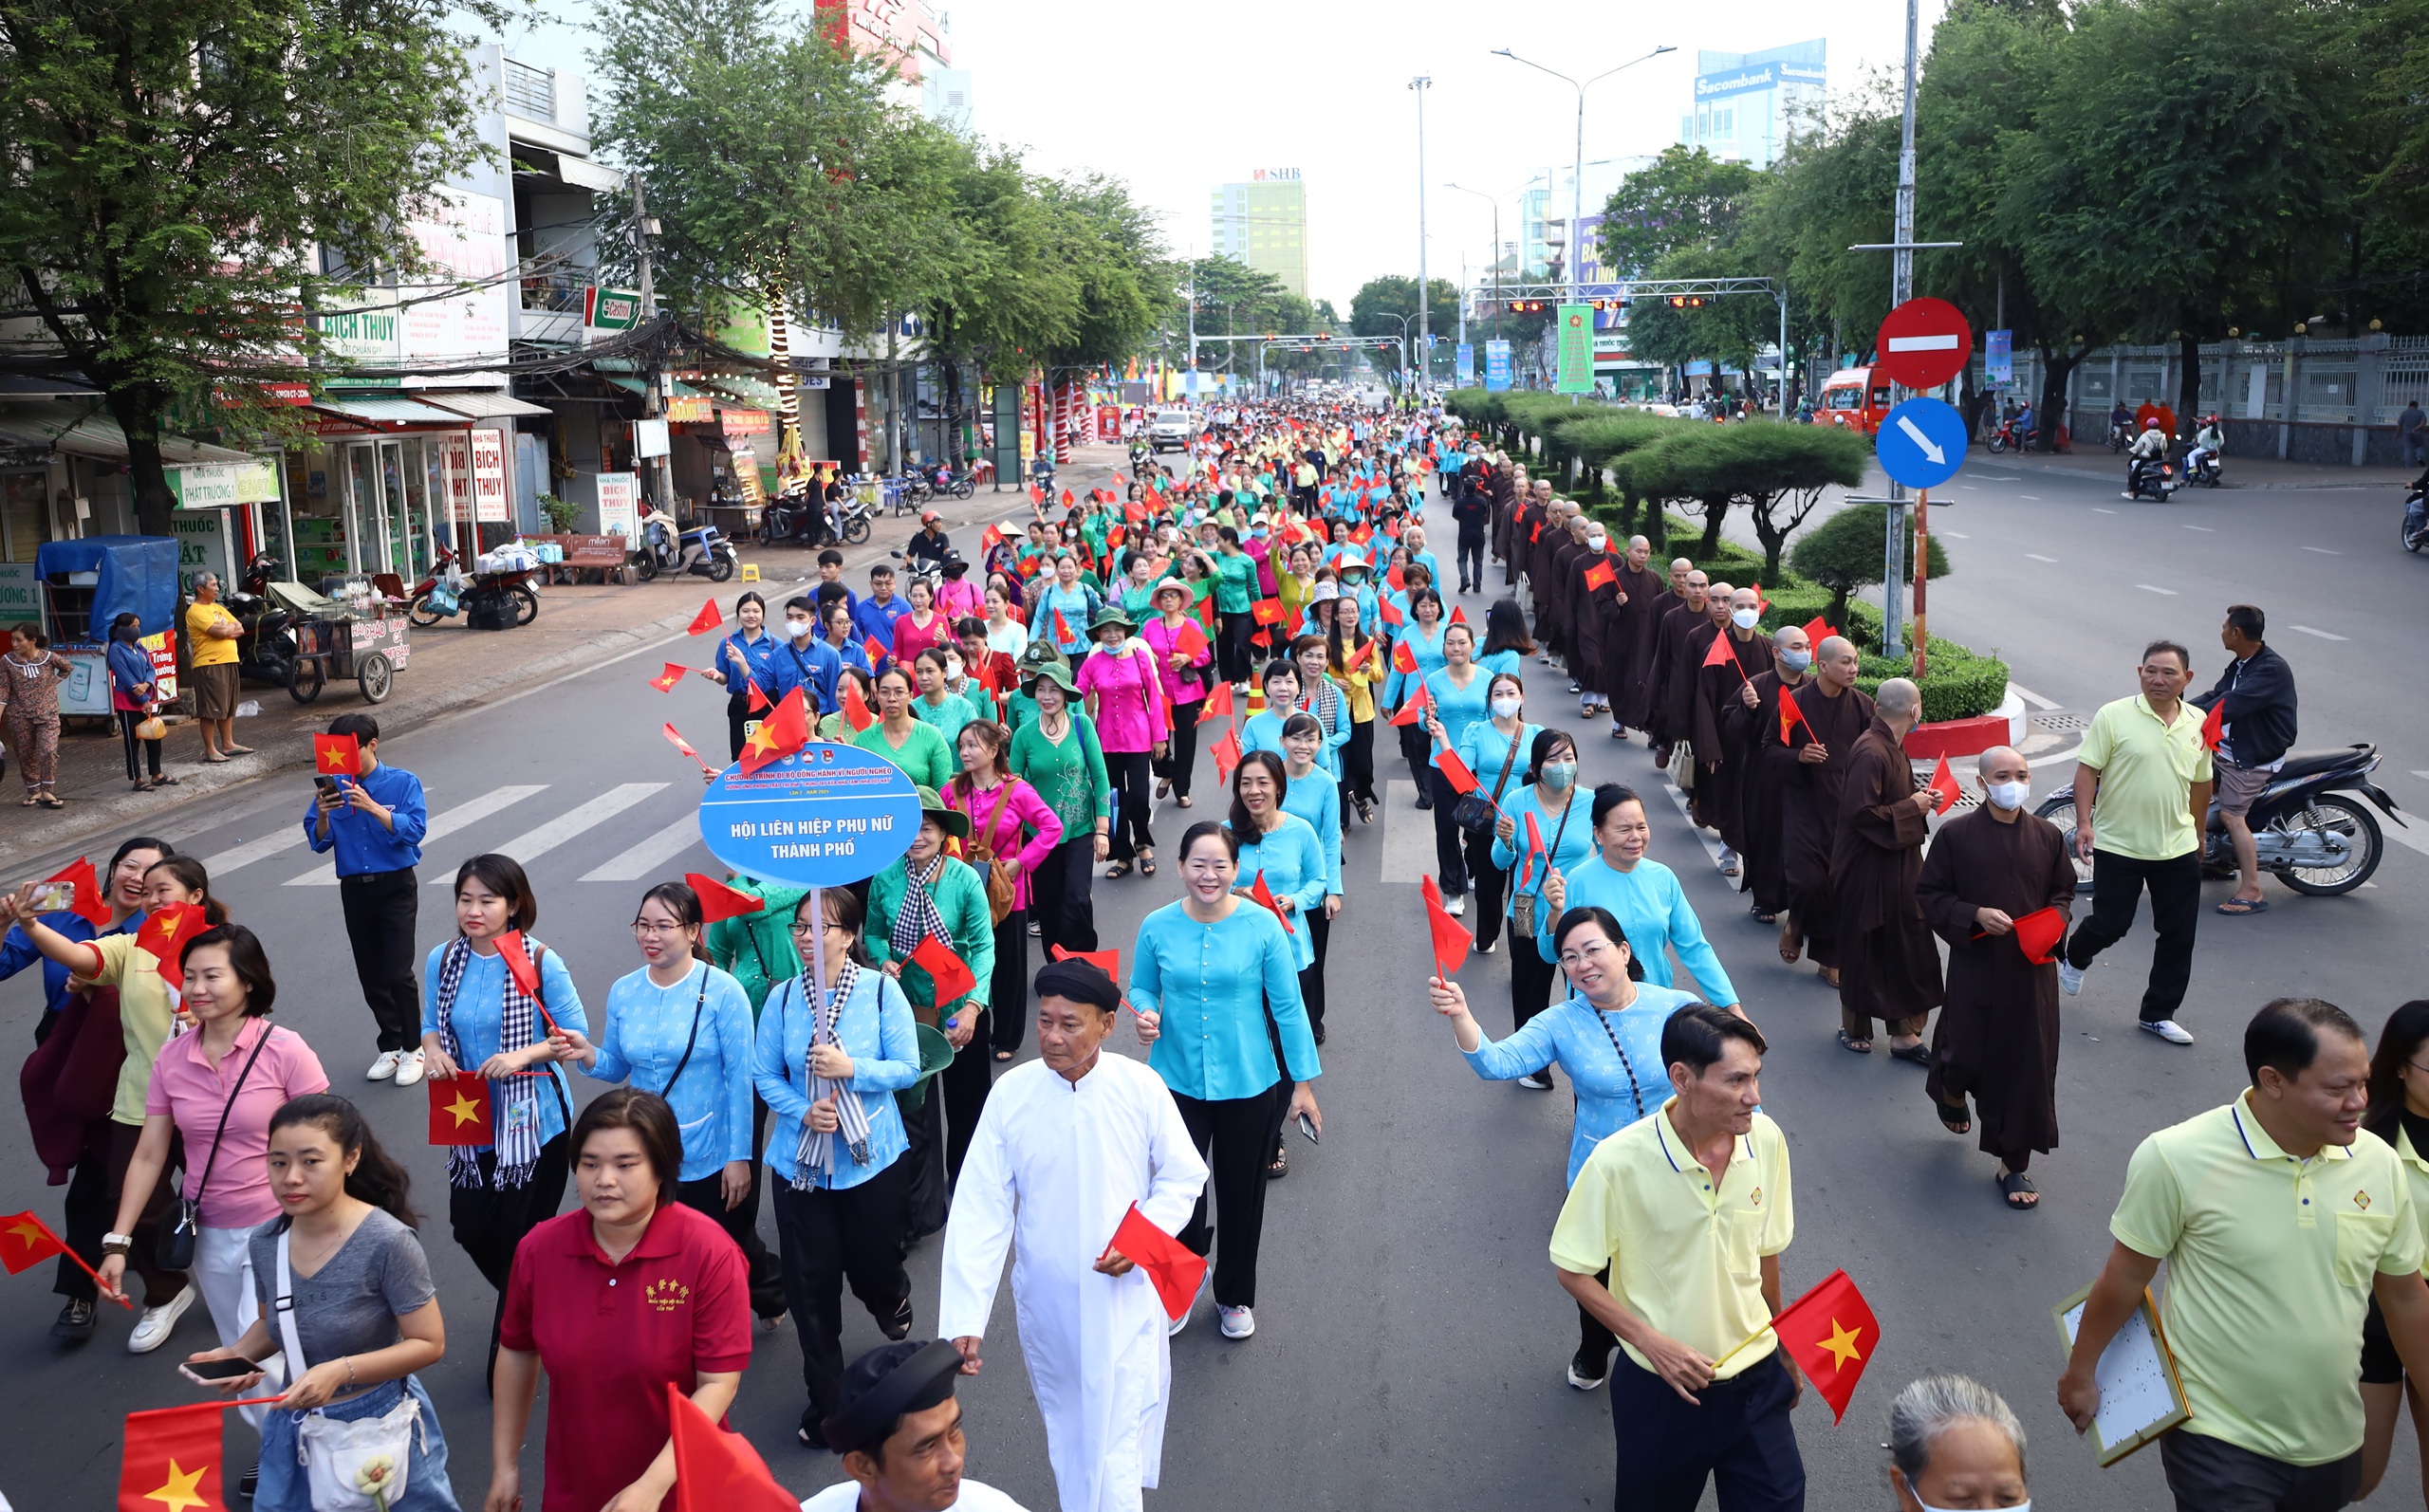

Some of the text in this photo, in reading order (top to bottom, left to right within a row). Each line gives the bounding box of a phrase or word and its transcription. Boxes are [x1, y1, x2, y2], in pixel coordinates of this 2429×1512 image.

[1780, 63, 1826, 79] Sacombank
[1697, 68, 1773, 95] Sacombank
[1270, 167, 1300, 180] SHB
[609, 302, 630, 320] Castrol
[473, 432, 498, 443] NHÀ THUỐC
[475, 446, 499, 469] BÍCH
[477, 471, 501, 496] THỦY
[603, 485, 626, 495] BÍCH
[185, 485, 202, 502] PHÁT
[602, 496, 629, 507] THỦY
[173, 516, 215, 533] THUỐC
[0, 568, 20, 578] HUỐC
[31, 588, 37, 604] 1
[755, 770, 775, 780] TRÌNH
[776, 771, 784, 779] ĐI
[786, 770, 795, 780] BỘ
[797, 769, 816, 778] ĐỒNG
[817, 768, 837, 778] HÀNH
[838, 768, 845, 777] VÌ
[846, 767, 867, 776] NGƯỜI
[869, 767, 892, 775] NGHÈO
[731, 814, 894, 839] HỘI LIÊN HIỆP PHỤ NỮ
[770, 837, 855, 859] THÀNH PHỐ
